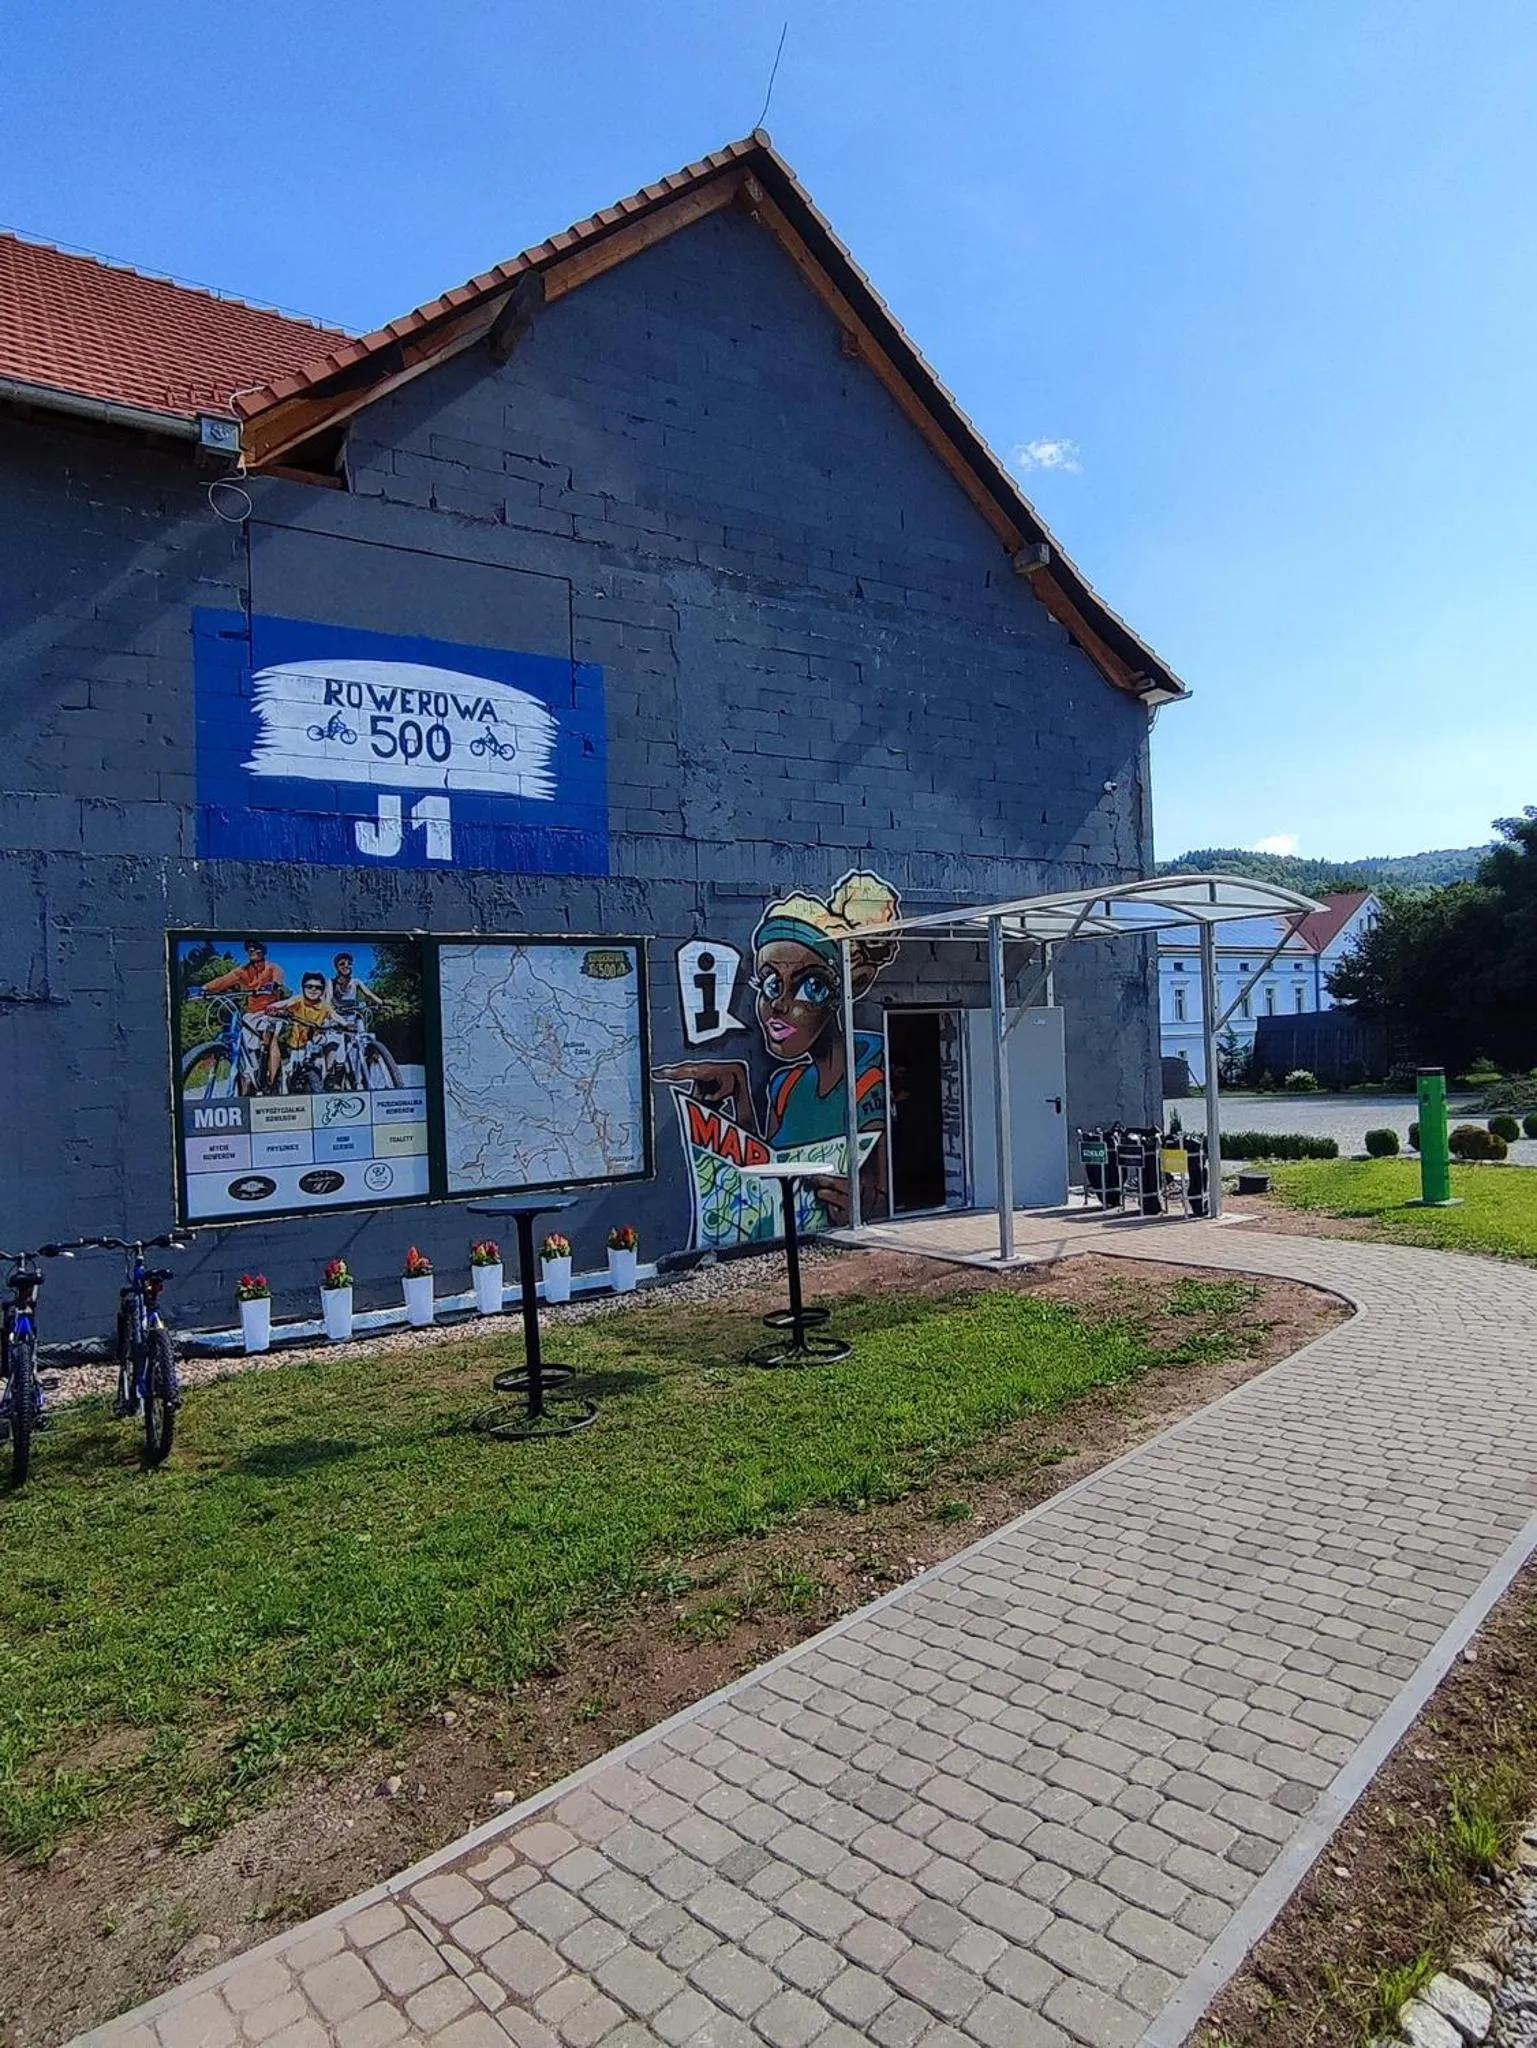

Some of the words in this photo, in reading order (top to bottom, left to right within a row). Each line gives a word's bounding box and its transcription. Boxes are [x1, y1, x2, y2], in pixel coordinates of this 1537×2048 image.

[324, 678, 501, 723] ROWEROWA
[369, 715, 453, 764] 500
[354, 794, 453, 862] J1
[194, 1107, 243, 1129] MOR
